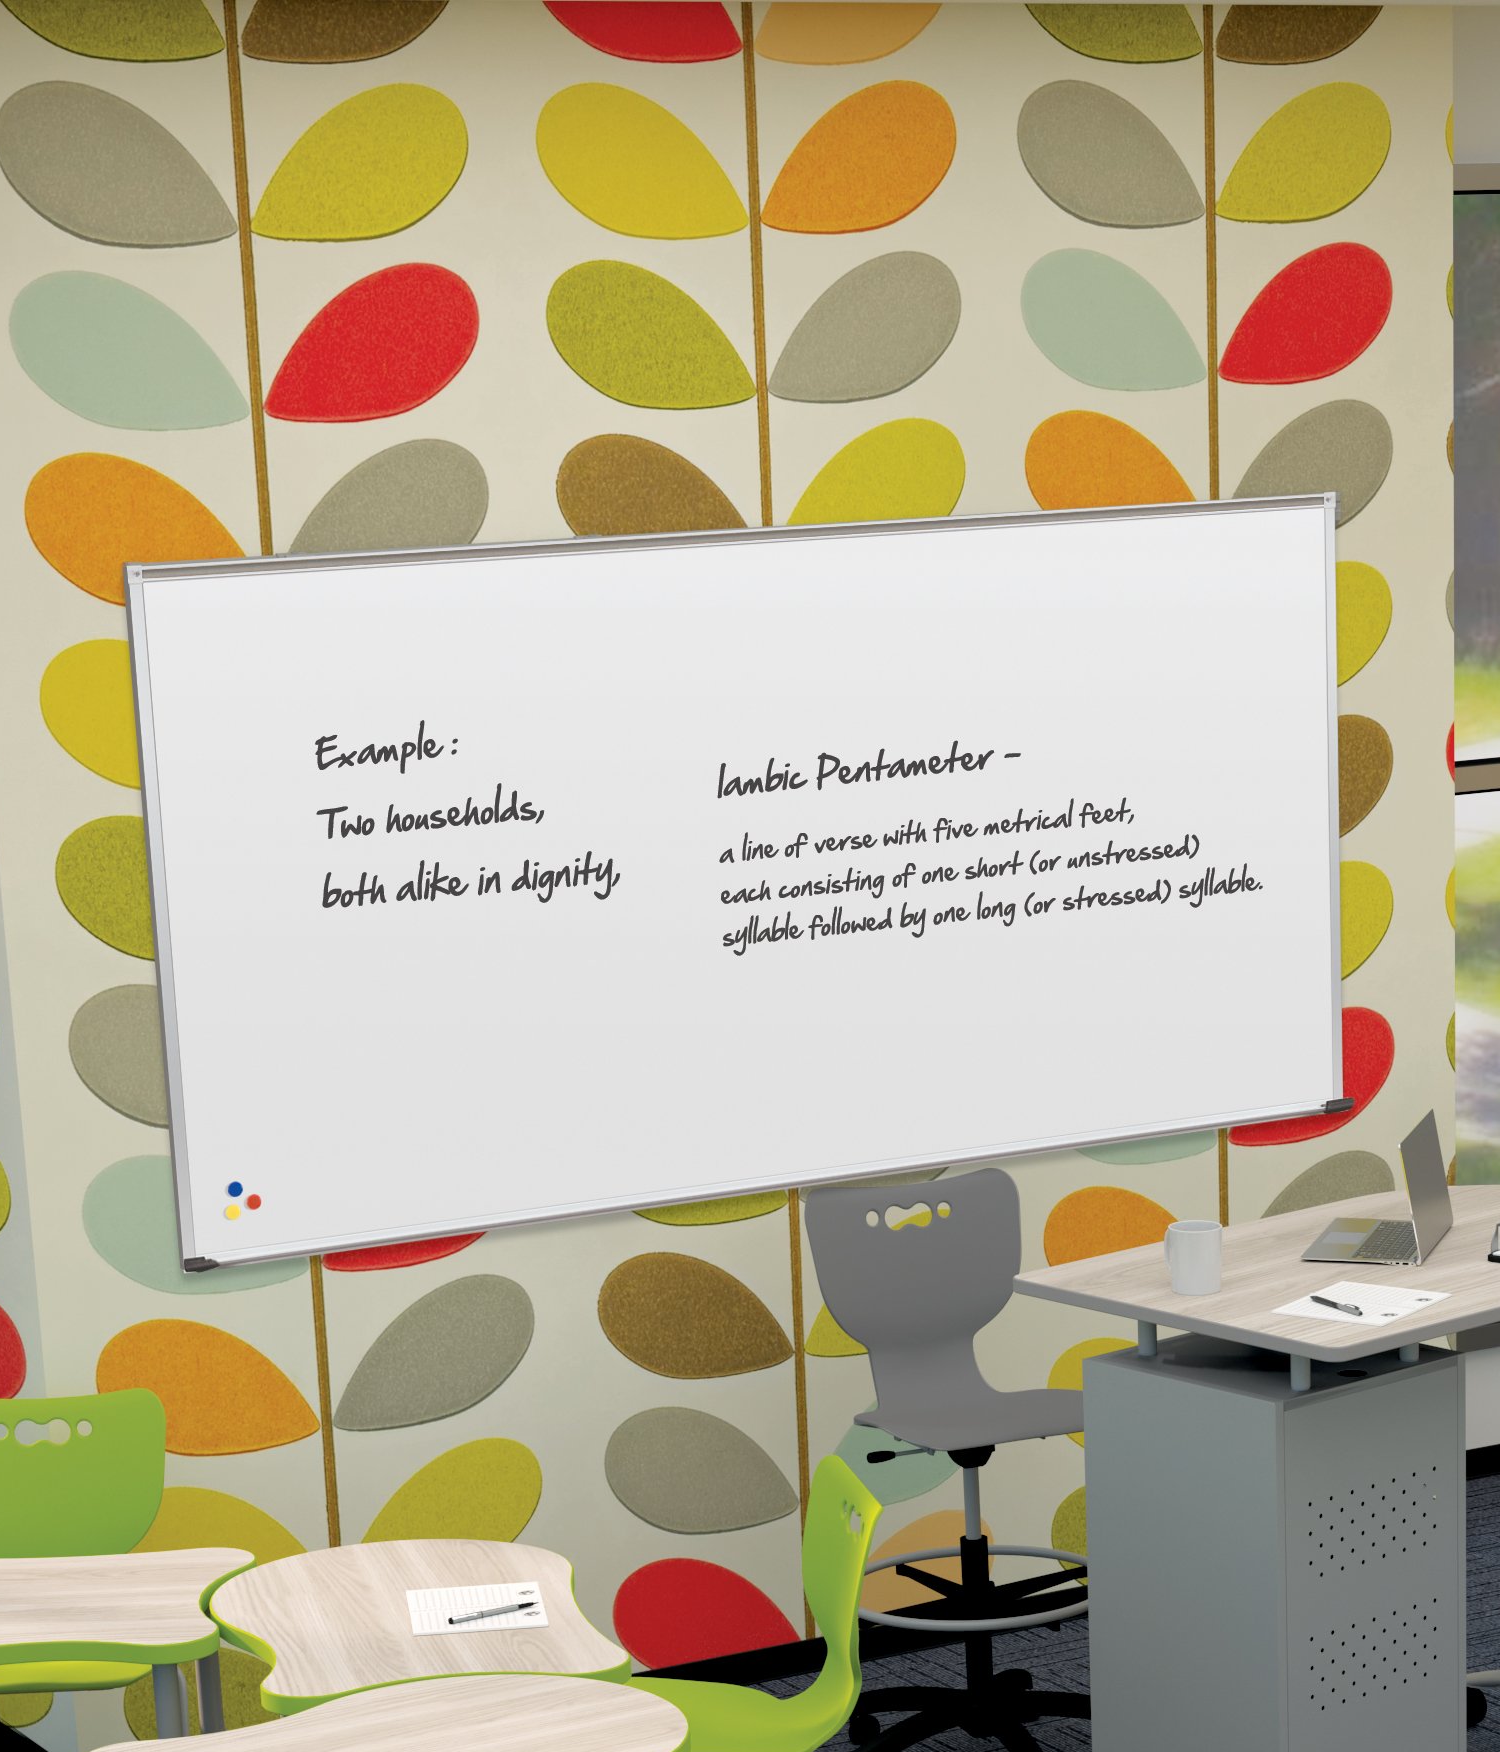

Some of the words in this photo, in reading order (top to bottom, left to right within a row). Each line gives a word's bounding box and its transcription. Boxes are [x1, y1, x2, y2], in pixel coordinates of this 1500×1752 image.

[717, 757, 808, 799] Iambic
[817, 740, 995, 791] Pentameter
[316, 806, 375, 839] Two
[386, 783, 545, 833] households,
[719, 848, 735, 864] a
[742, 832, 780, 861] line
[784, 832, 809, 859] of
[814, 834, 878, 854] verse
[883, 819, 927, 846] with
[933, 817, 979, 843] five
[983, 798, 1075, 836] metrical
[1079, 797, 1135, 829] feet,
[322, 871, 387, 908] both
[396, 860, 469, 902] alike
[477, 866, 501, 896] in
[511, 850, 621, 903] dignity,
[720, 879, 771, 905] each
[778, 867, 885, 899] consisting
[892, 862, 917, 888] of
[921, 866, 960, 884] one
[965, 850, 1024, 880] short
[1029, 850, 1062, 875] (or
[1067, 834, 1200, 870] unstressed)
[722, 911, 804, 956] syllable
[808, 906, 893, 941] followed
[900, 901, 927, 938] by
[933, 905, 971, 925] one
[976, 891, 1016, 927] long
[1024, 892, 1056, 917] (or
[1062, 879, 1172, 911] stressed)
[1179, 863, 1264, 908] syllable.
